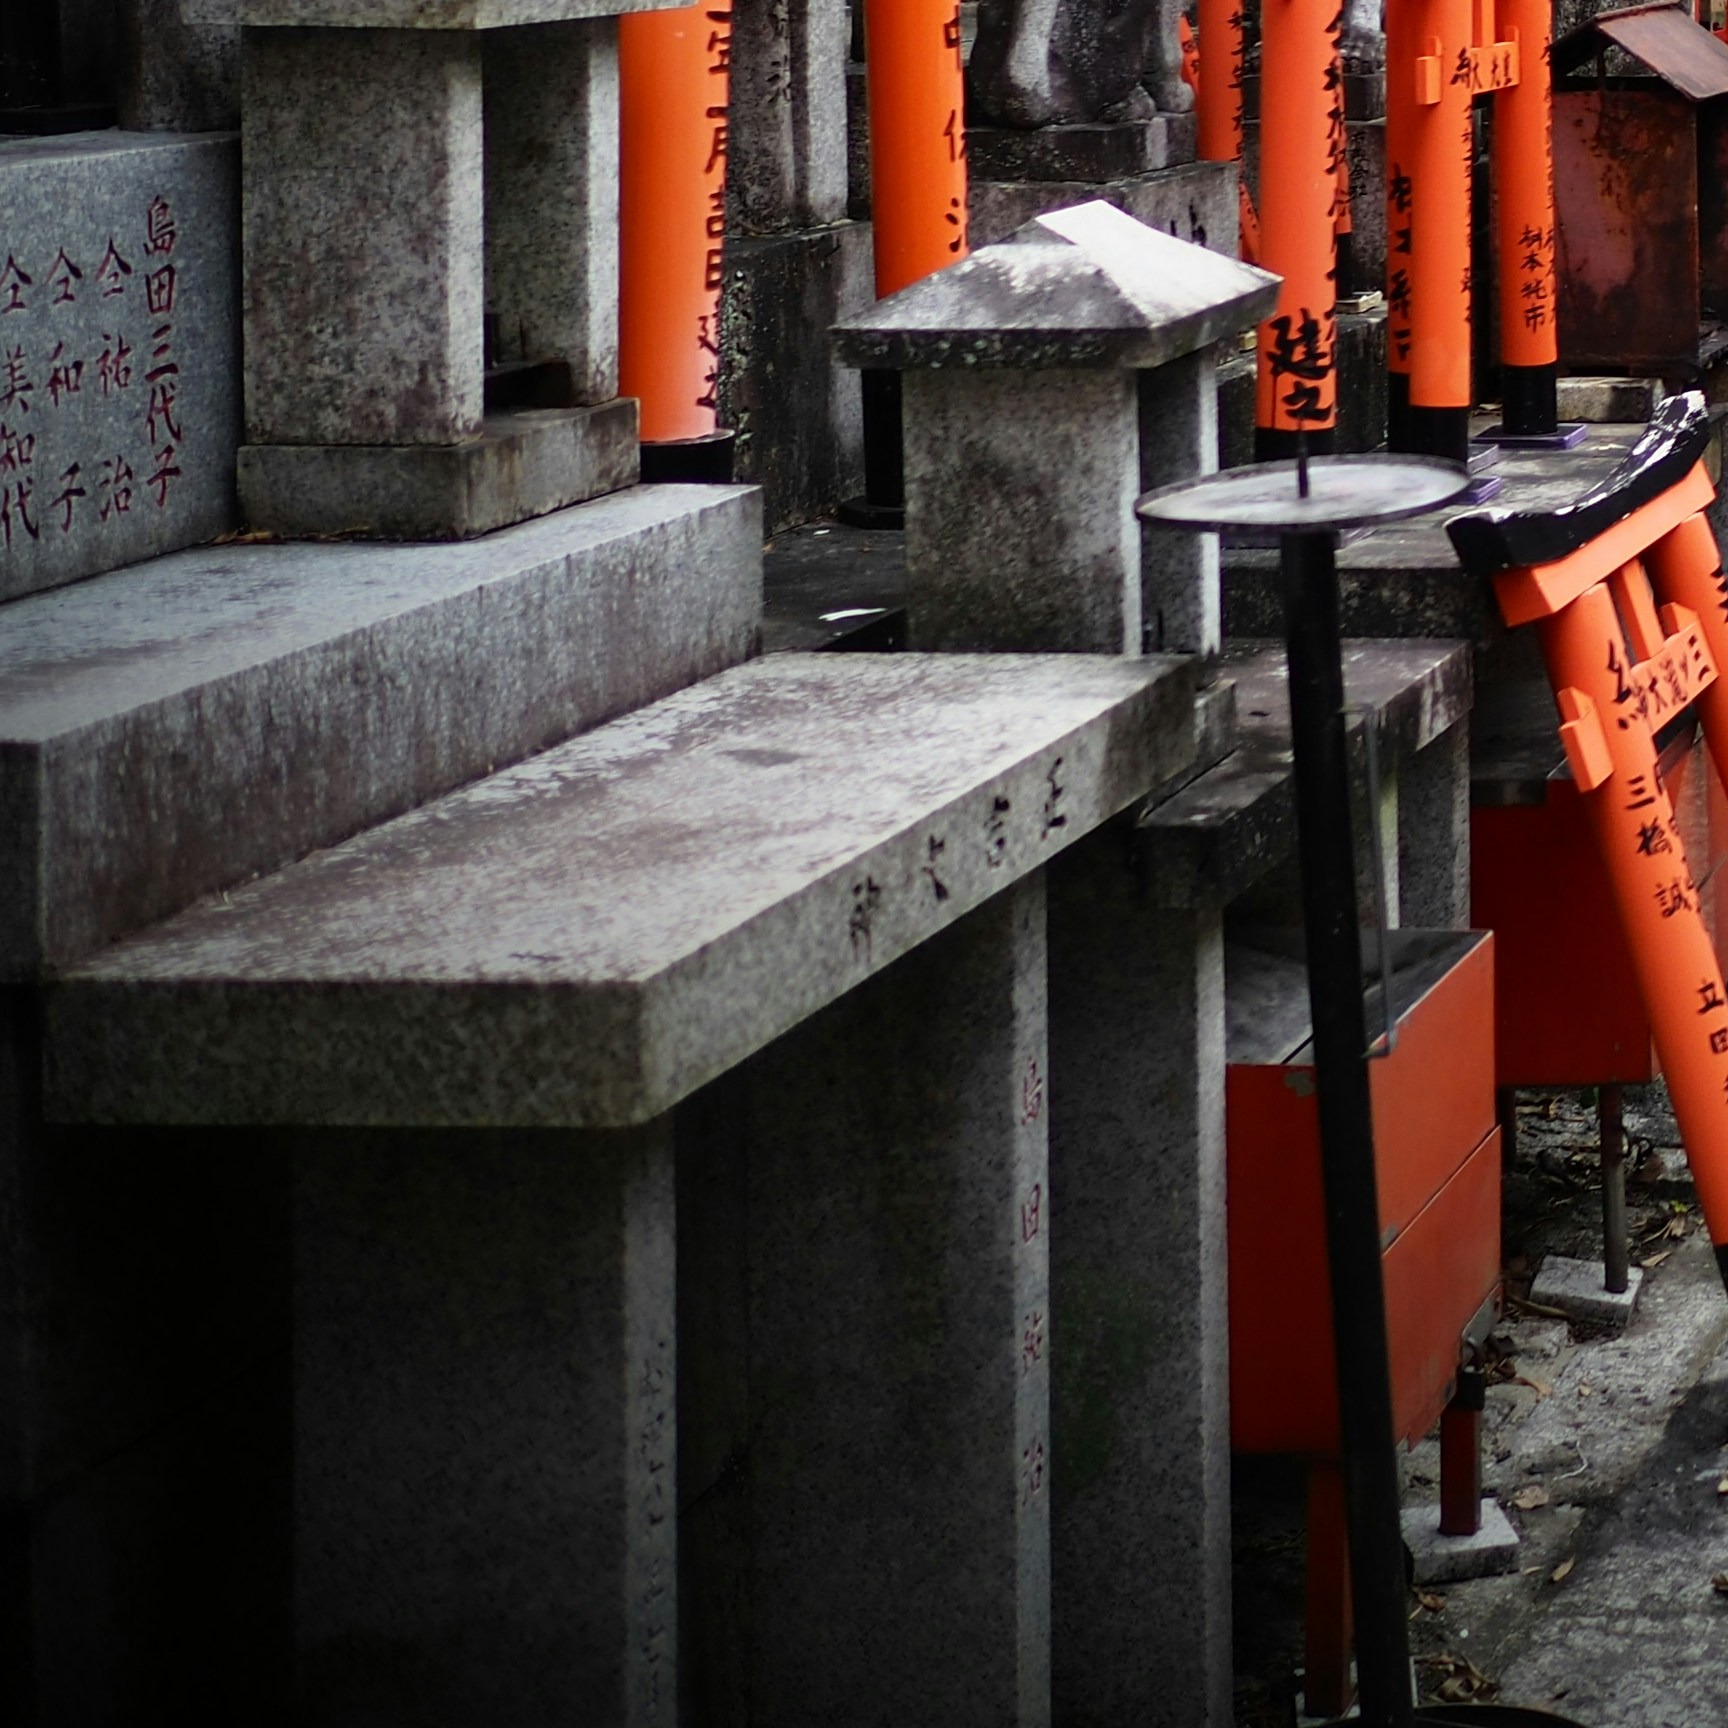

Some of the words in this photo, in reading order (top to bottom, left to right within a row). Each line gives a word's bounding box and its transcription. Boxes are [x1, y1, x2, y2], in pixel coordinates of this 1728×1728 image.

[143, 194, 183, 511] 島田三代子
[1266, 307, 1334, 422] 建之
